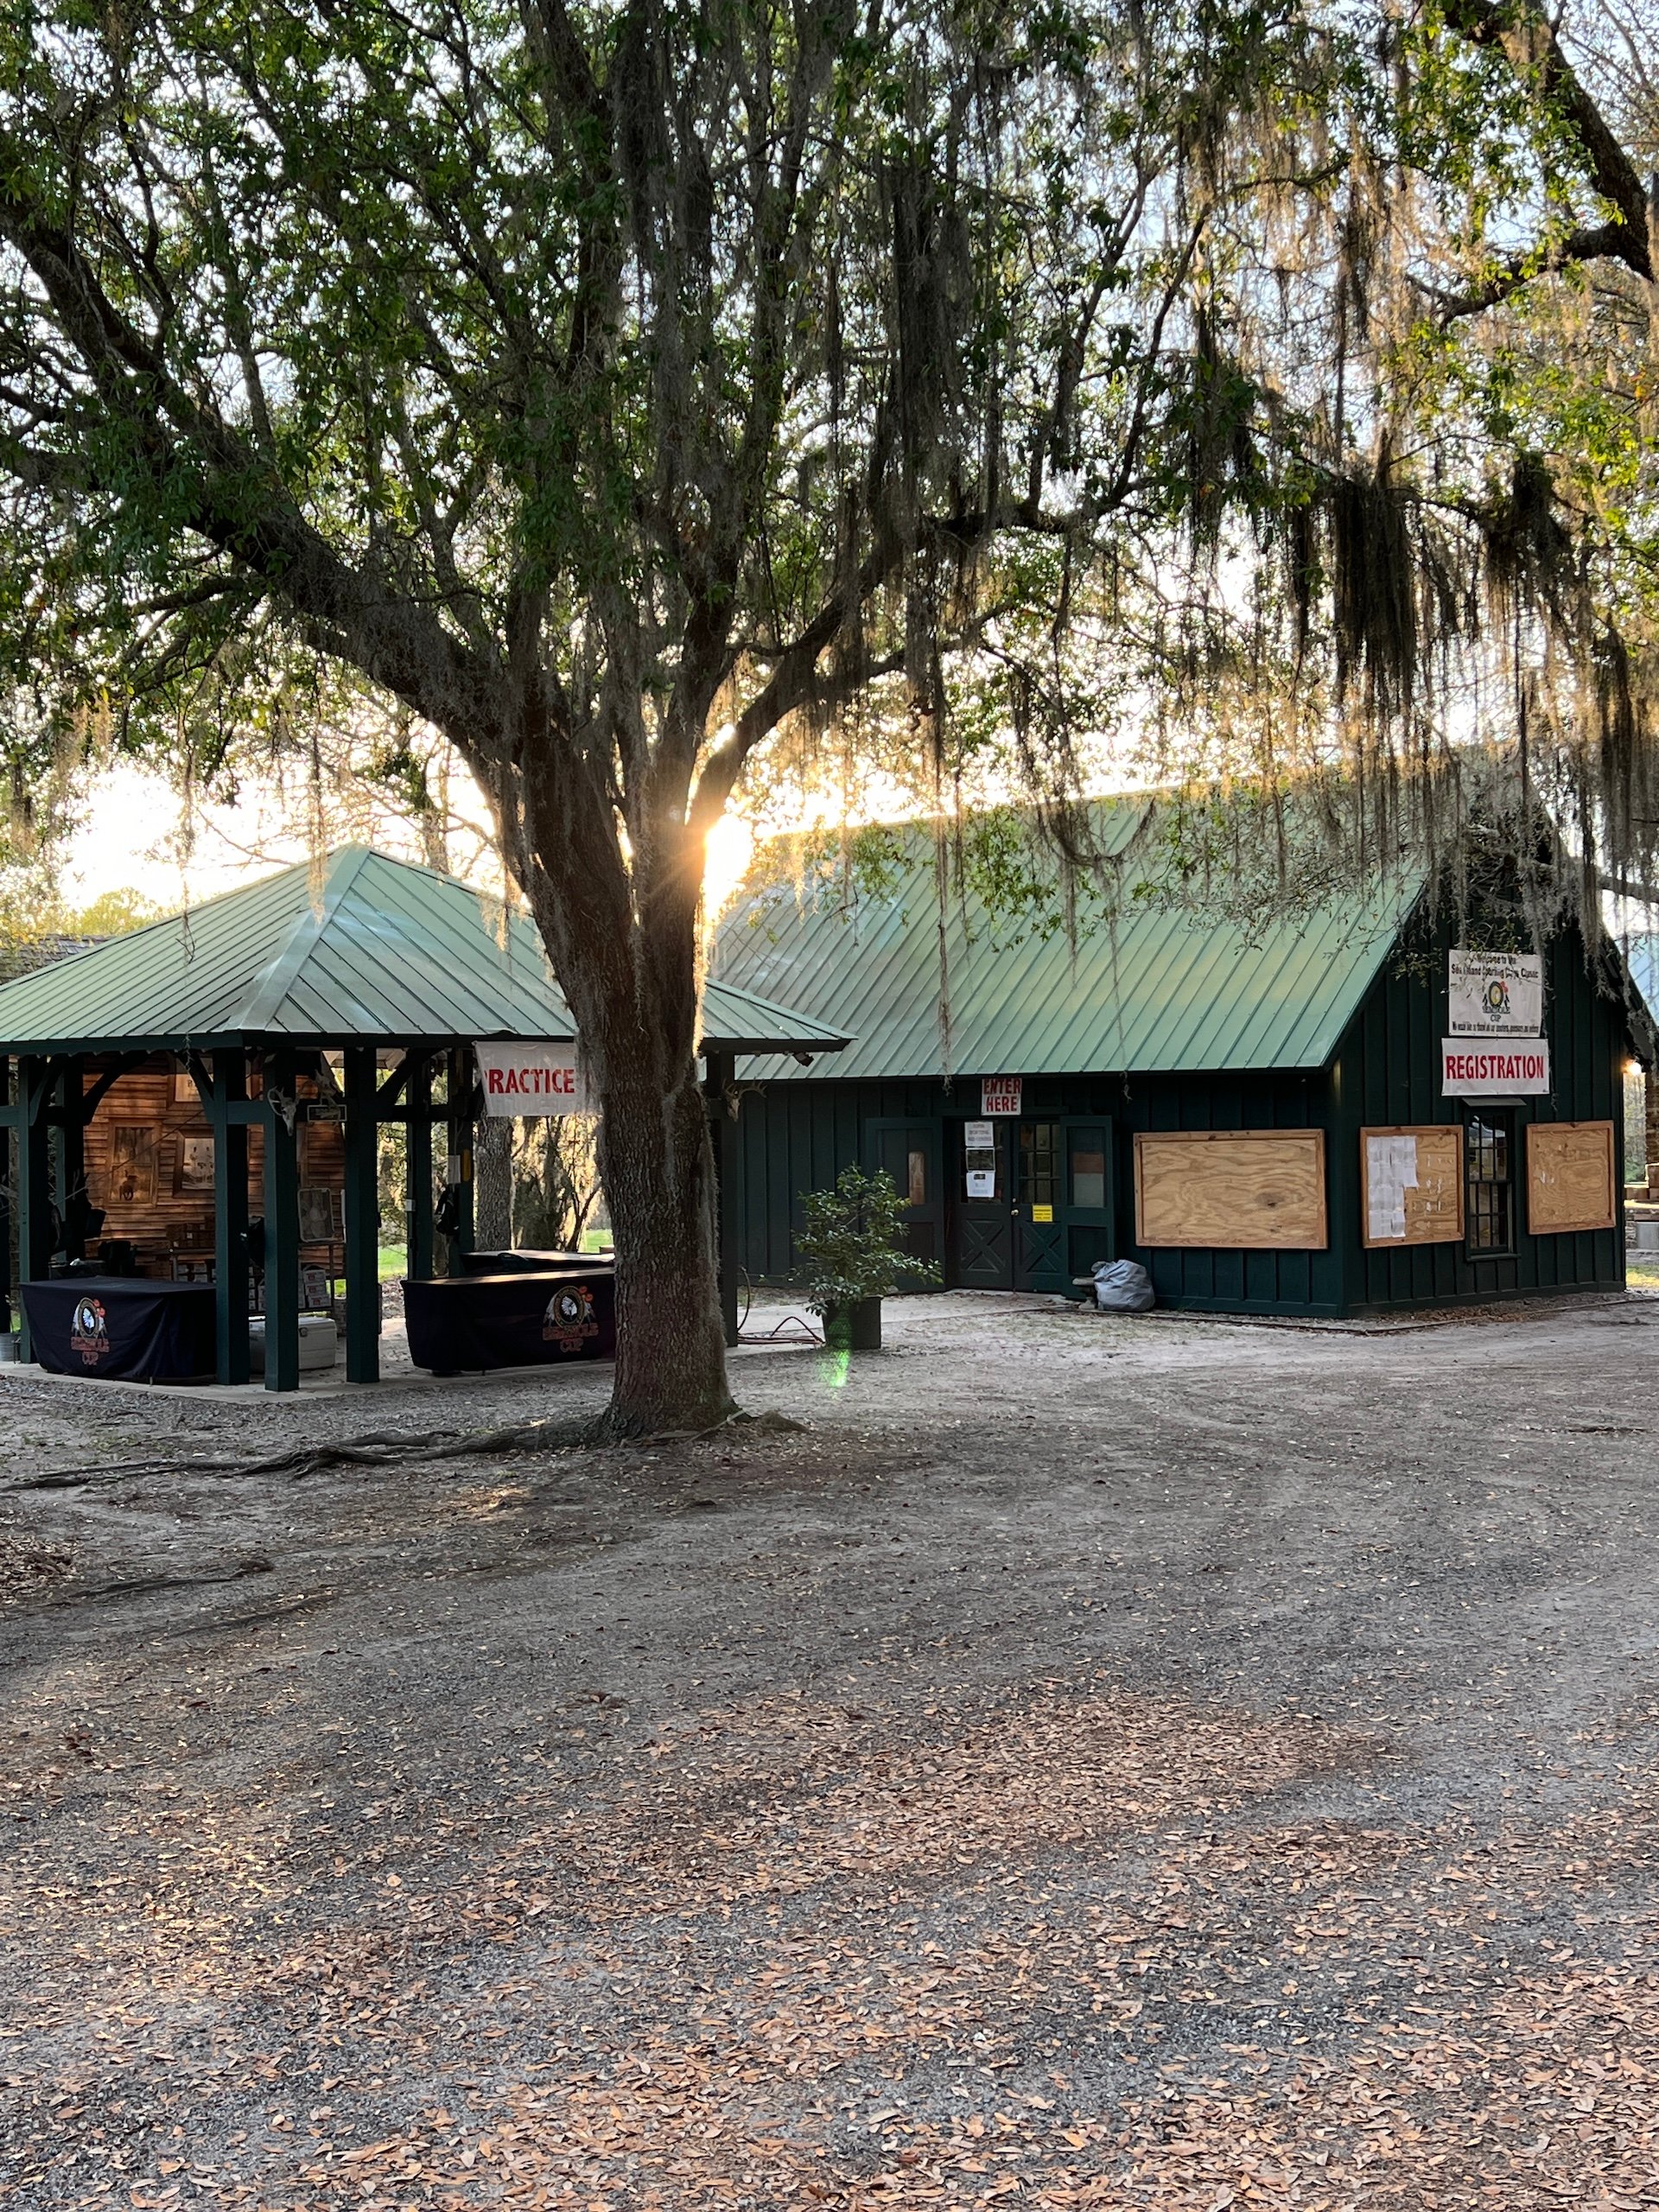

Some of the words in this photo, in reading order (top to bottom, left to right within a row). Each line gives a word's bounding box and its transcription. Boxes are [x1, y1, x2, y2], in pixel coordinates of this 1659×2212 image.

[1446, 1055, 1544, 1079] REGISTRATION
[485, 1068, 575, 1094] RACTICE
[983, 1078, 1021, 1095] ENTER
[986, 1096, 1018, 1112] HERE
